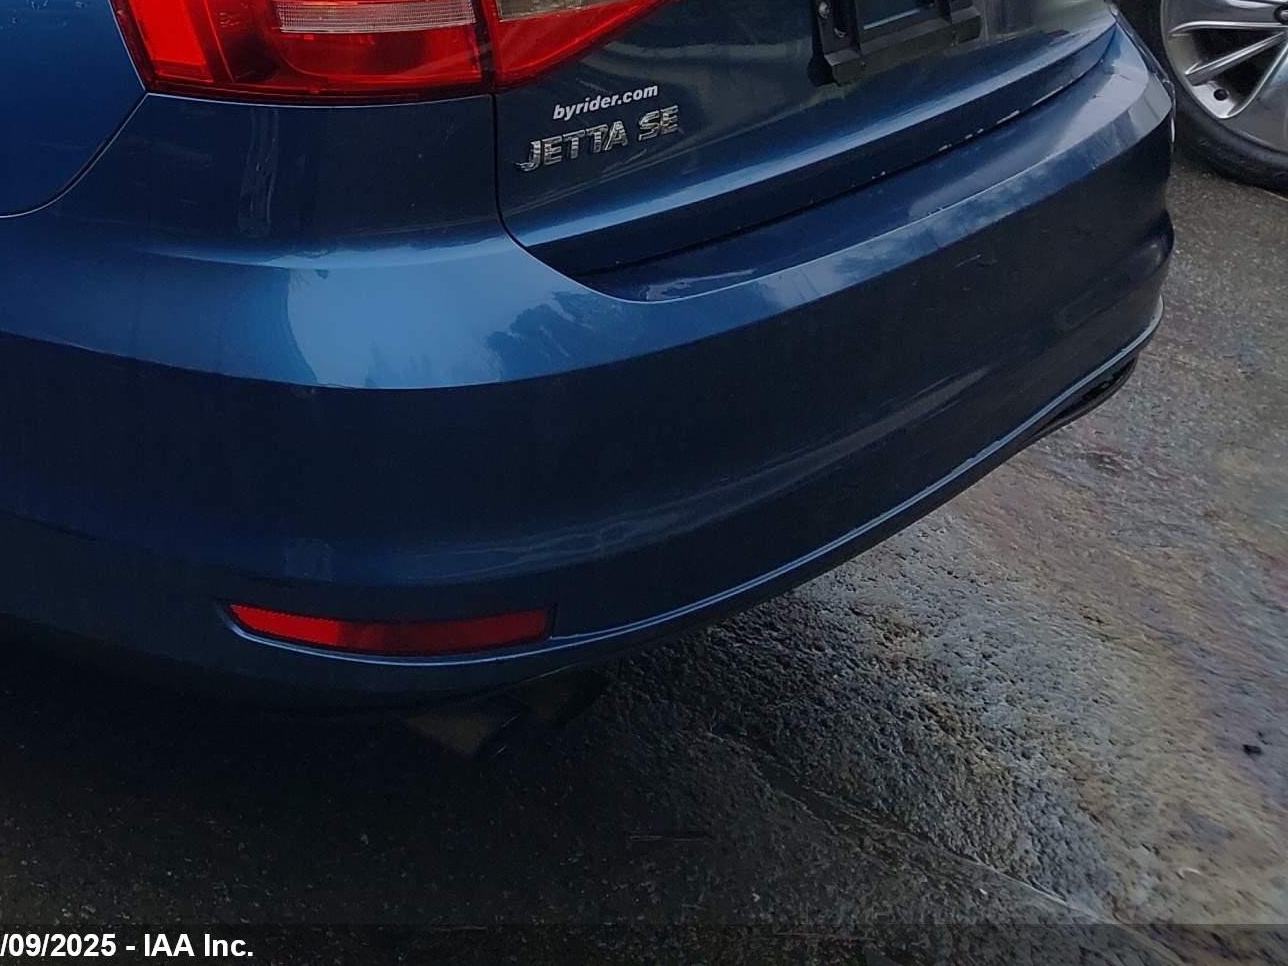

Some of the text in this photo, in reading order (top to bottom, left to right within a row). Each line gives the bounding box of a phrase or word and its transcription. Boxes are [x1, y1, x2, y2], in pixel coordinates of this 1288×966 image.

[553, 85, 658, 121] byrider.com
[513, 105, 680, 172] JETTA SE
